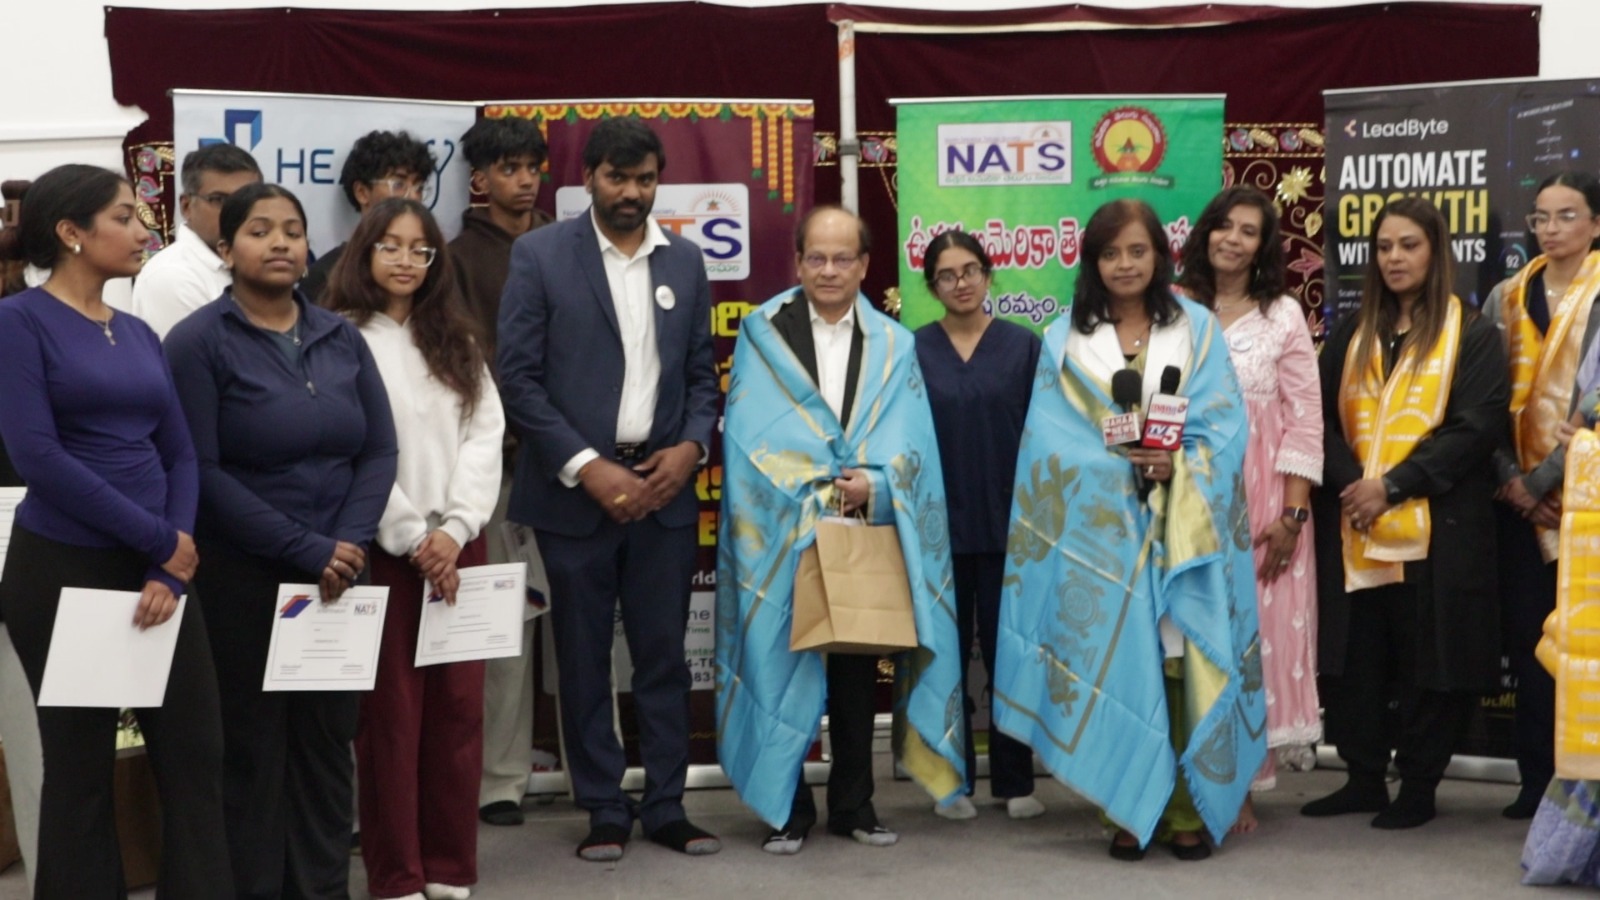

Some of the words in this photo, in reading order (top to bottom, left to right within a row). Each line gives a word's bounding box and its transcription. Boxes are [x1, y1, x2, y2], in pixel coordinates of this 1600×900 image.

[1362, 118, 1449, 140] LeadByte
[946, 141, 1066, 174] NATS
[1338, 149, 1488, 190] AUTOMATE
[1338, 189, 1488, 238] GRTH
[1338, 241, 1370, 265] WIT
[1505, 254, 1520, 269] 92
[1149, 424, 1182, 446] TV5
